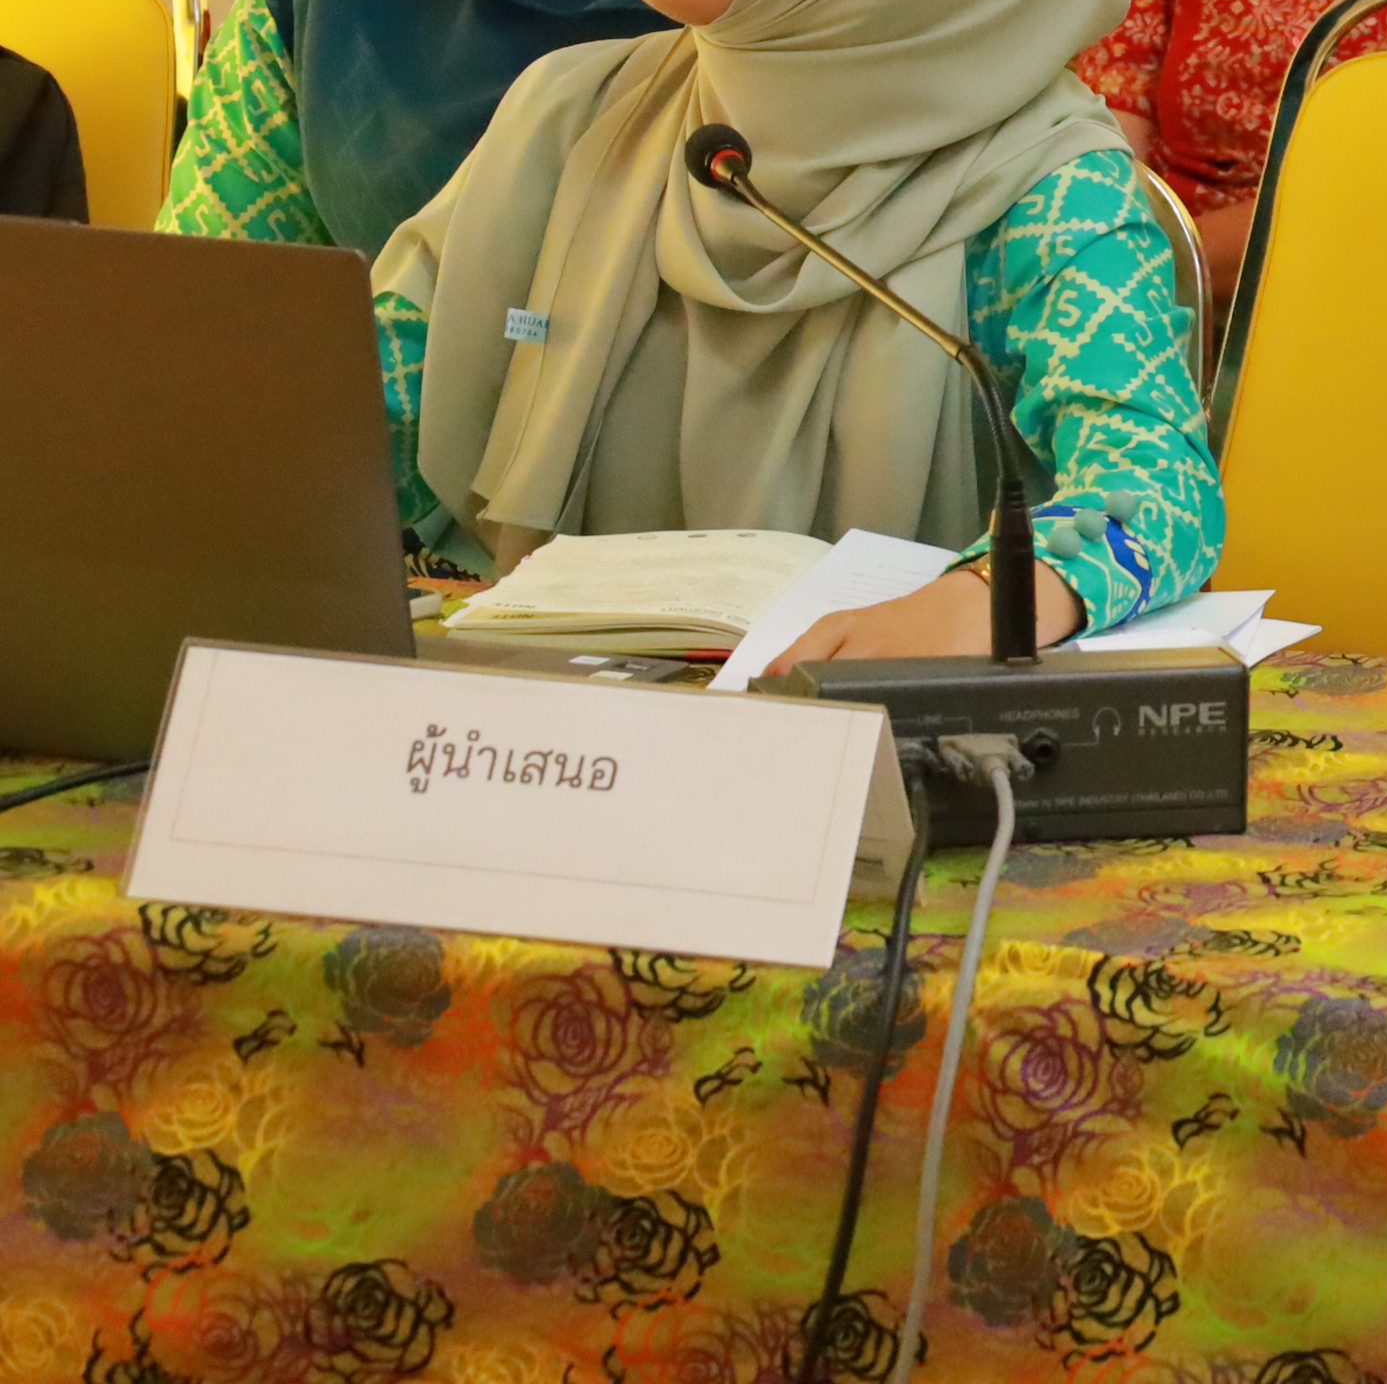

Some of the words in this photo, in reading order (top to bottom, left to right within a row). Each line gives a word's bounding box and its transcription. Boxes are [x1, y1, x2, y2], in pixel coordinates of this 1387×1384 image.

[1139, 702, 1227, 727] NPE
[406, 723, 618, 794] ผู้นำเสนอ
